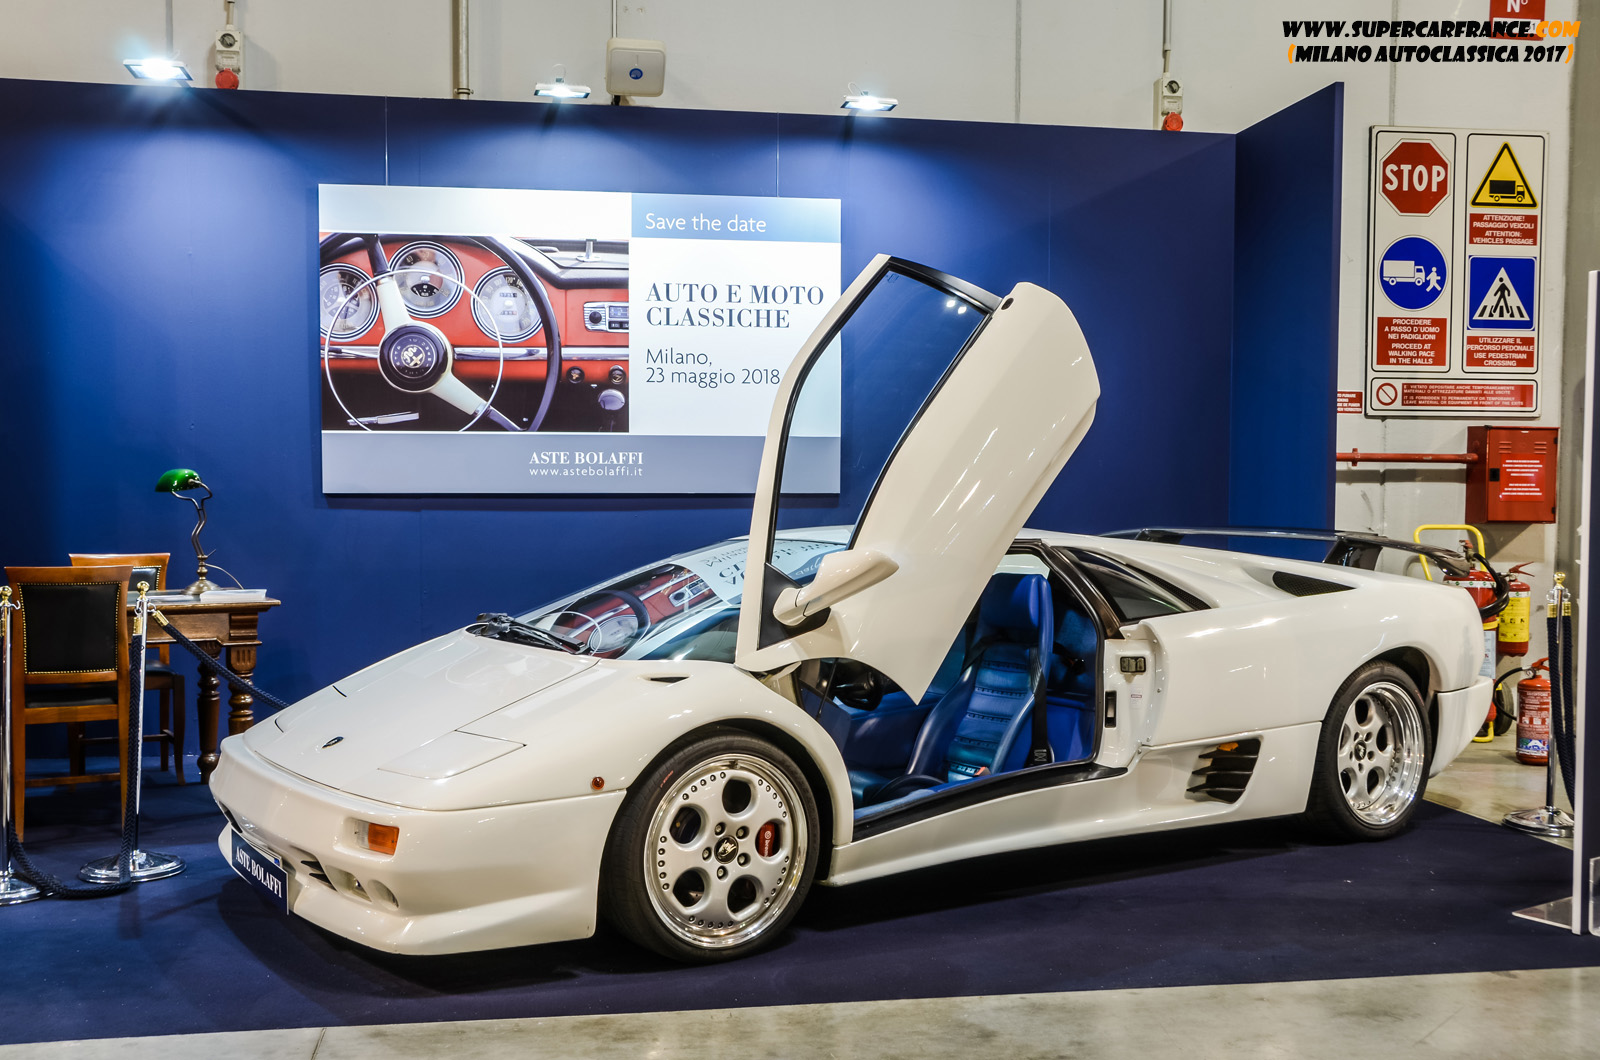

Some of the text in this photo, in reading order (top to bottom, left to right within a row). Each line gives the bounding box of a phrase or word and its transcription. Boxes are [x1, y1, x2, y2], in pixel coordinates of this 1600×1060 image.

[1385, 163, 1446, 192] STOP
[645, 213, 767, 232] Save the date
[646, 283, 824, 305] AUTO E MOTO
[646, 307, 790, 328] CLASSICHE
[646, 347, 712, 366] Milano,
[646, 367, 780, 388] 23 maggio 2018
[529, 452, 644, 465] ASTE BOLAFFI
[529, 466, 643, 476] www.astebolaffi.it
[236, 846, 282, 898] ASTE BOLAFFI
